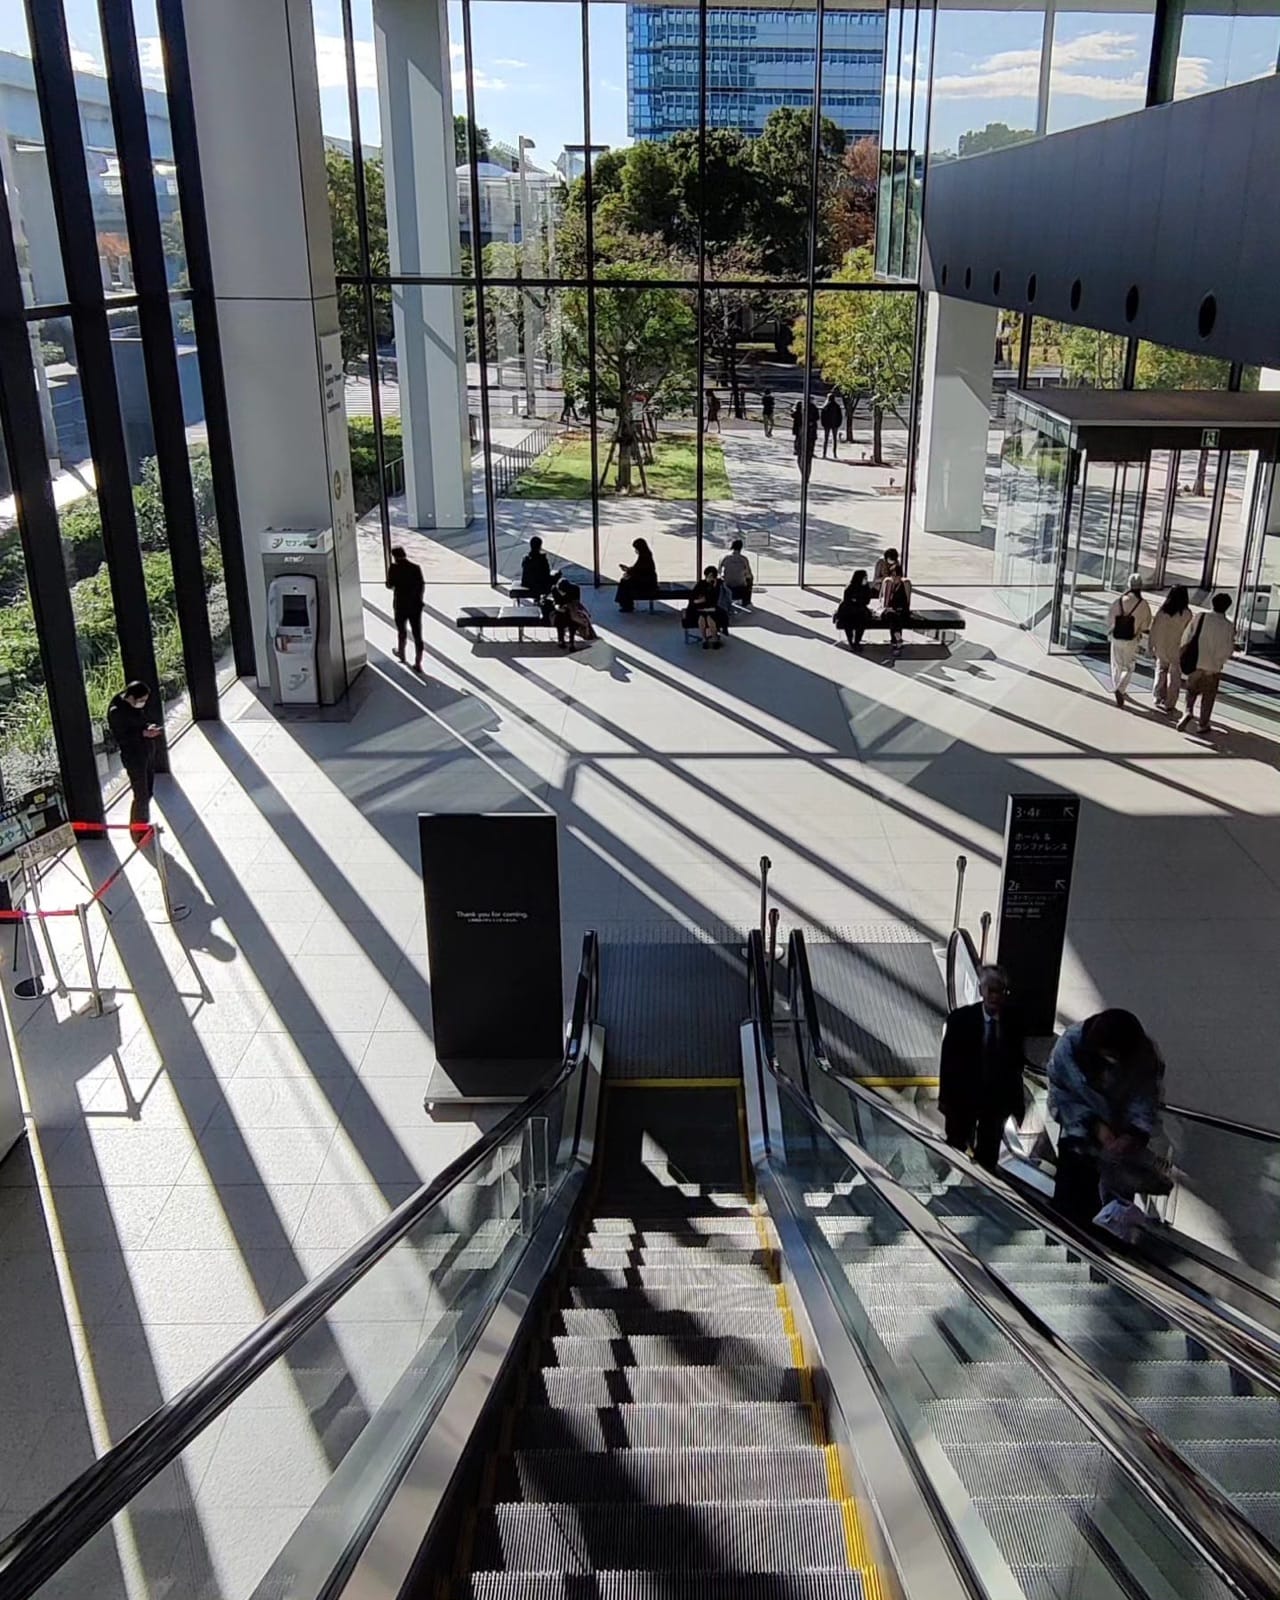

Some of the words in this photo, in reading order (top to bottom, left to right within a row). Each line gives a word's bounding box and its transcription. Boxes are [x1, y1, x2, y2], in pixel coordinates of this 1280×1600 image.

[1007, 879, 1021, 891] 2F
[456, 910, 476, 918] Thank
[478, 911, 491, 919] you
[491, 910, 501, 918] for
